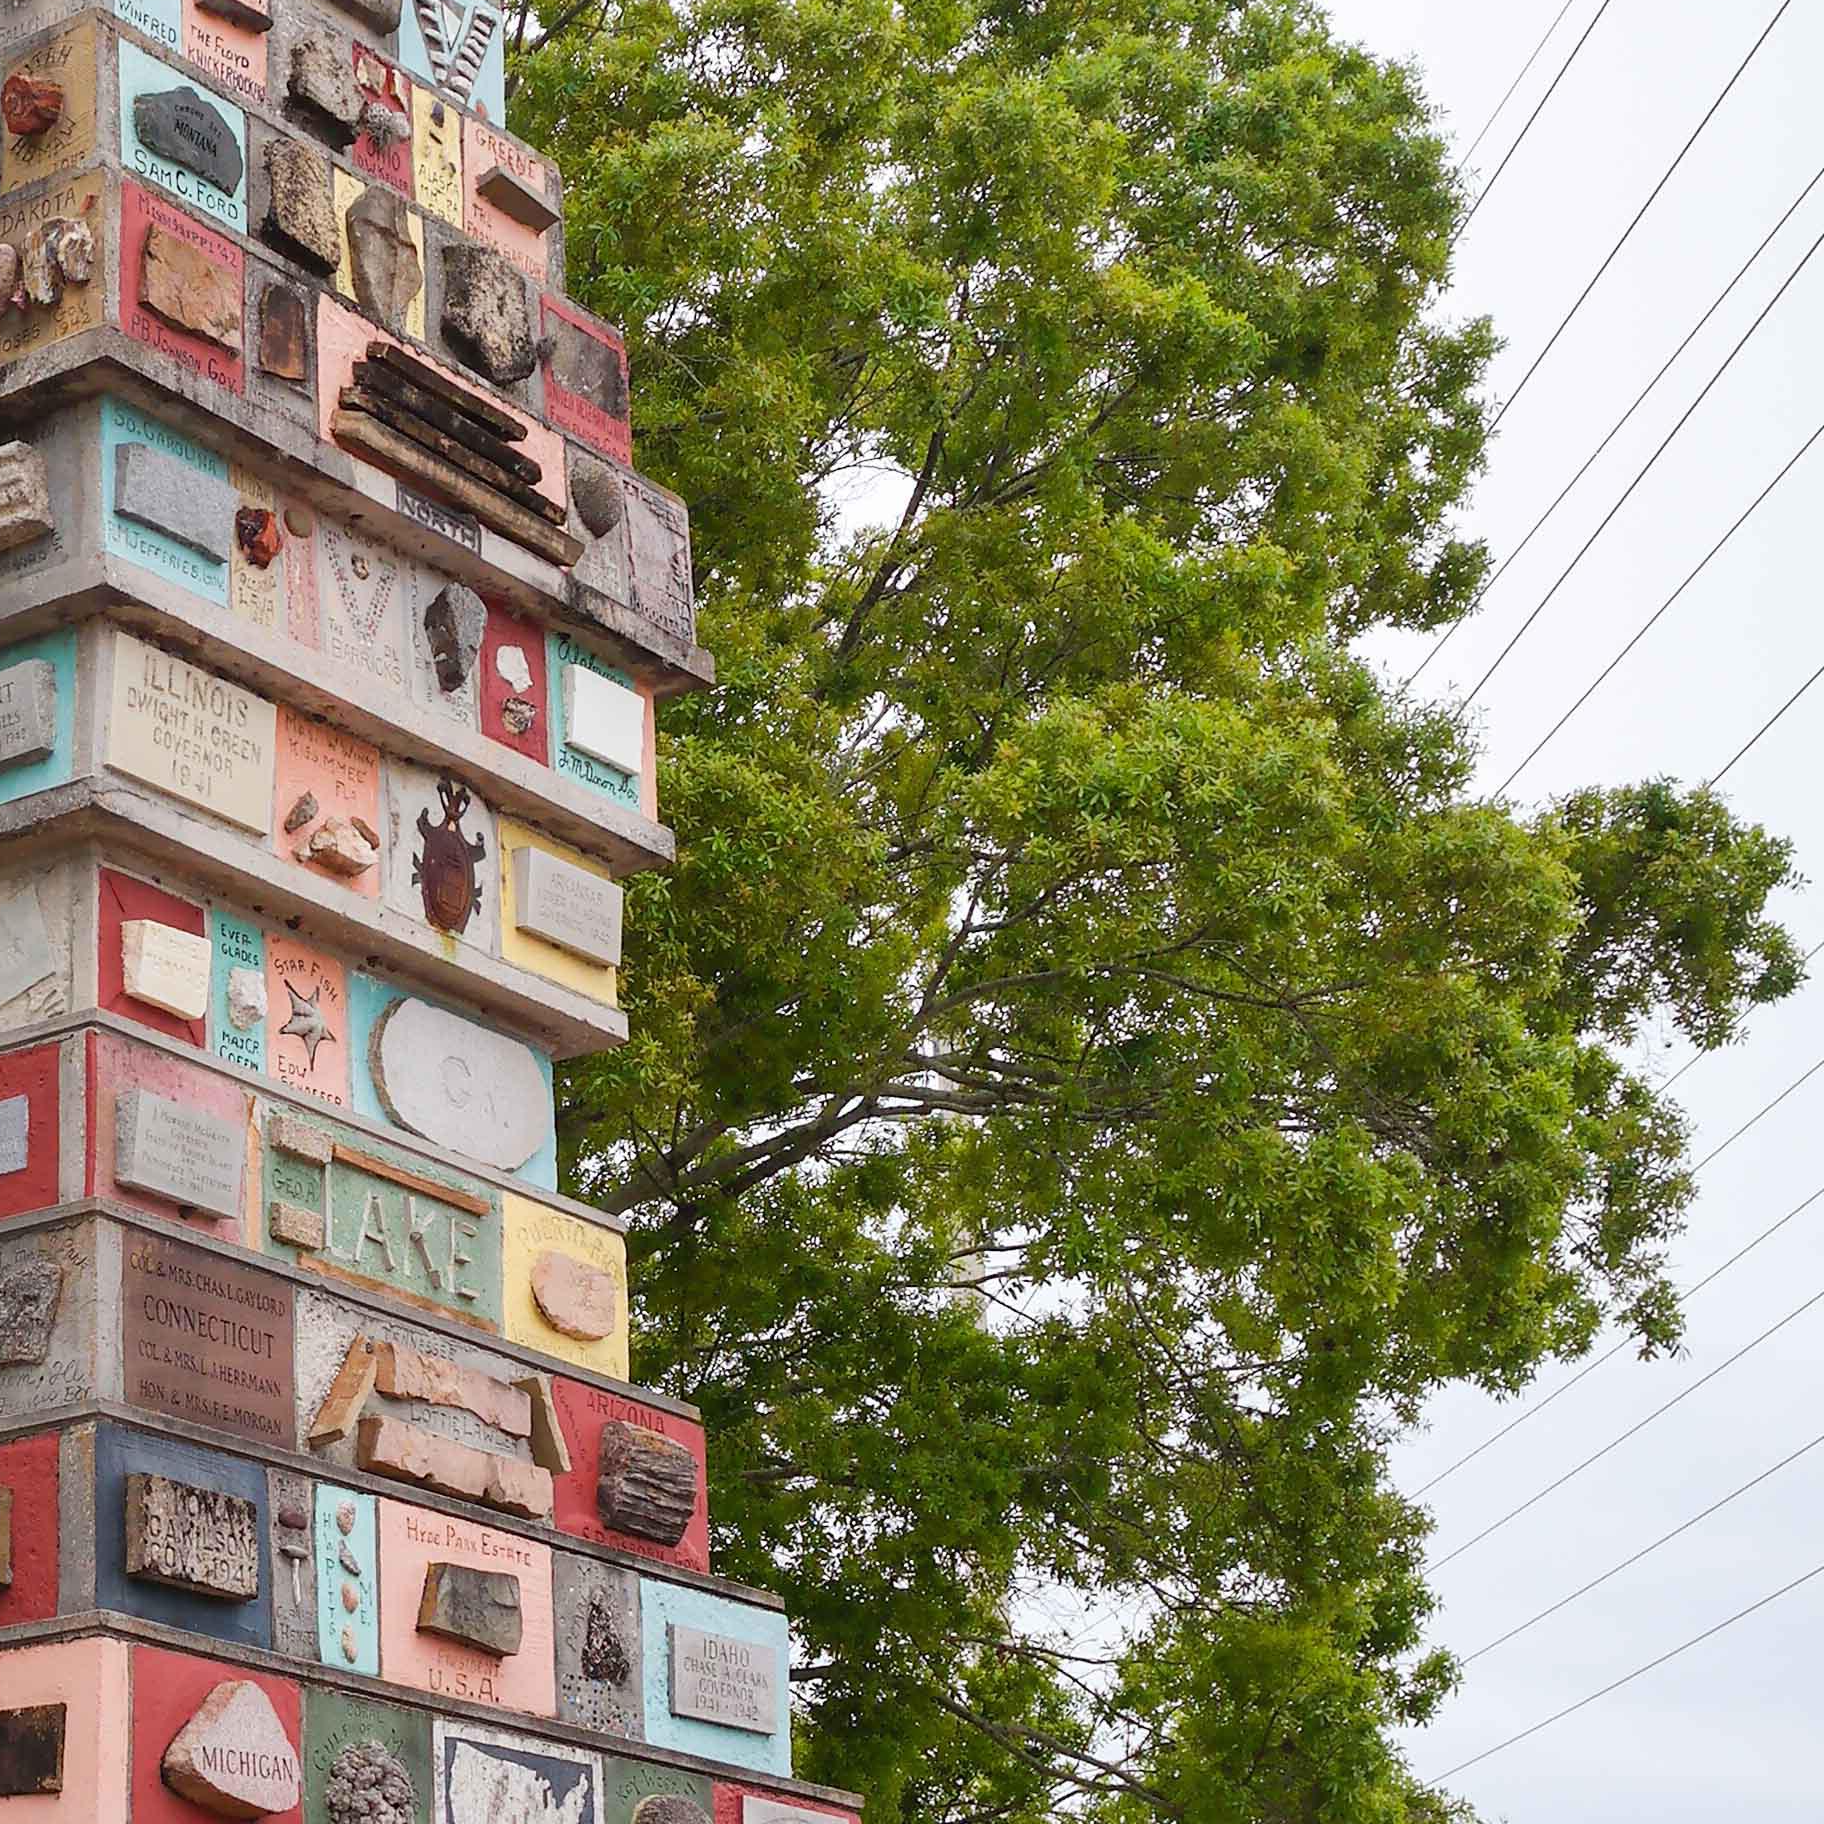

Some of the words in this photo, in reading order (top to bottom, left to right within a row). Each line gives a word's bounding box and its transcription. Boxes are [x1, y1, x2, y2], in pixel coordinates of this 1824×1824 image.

[216, 37, 249, 70] FLOYD
[176, 120, 217, 158] MONTANA
[135, 150, 174, 185] SAM
[197, 179, 239, 221] FORD
[401, 490, 475, 548] NORTH
[144, 654, 248, 727] ILLINOIS
[127, 687, 187, 729] DWIGHT
[210, 725, 261, 764] GREEN
[153, 727, 233, 777] GOVERNOR
[221, 943, 259, 967] GLADES
[324, 1161, 478, 1300] LAKE
[143, 1294, 274, 1360] CONNECTICUT
[234, 1408, 281, 1435] MORGAN
[586, 1390, 666, 1434] ARIZONA
[406, 1516, 441, 1546] HYDE
[445, 1524, 476, 1553] PARK
[480, 1532, 532, 1567] ESTATE
[702, 1638, 751, 1666] IDAHO
[428, 1668, 501, 1704] U.S.A.
[683, 1656, 718, 1678] CHASE
[733, 1666, 769, 1690] CLARK
[698, 1676, 755, 1703] GOVERNOR
[694, 1692, 721, 1714] 1941
[733, 1701, 760, 1722] 1942
[200, 1745, 294, 1782] MICHIGAN
